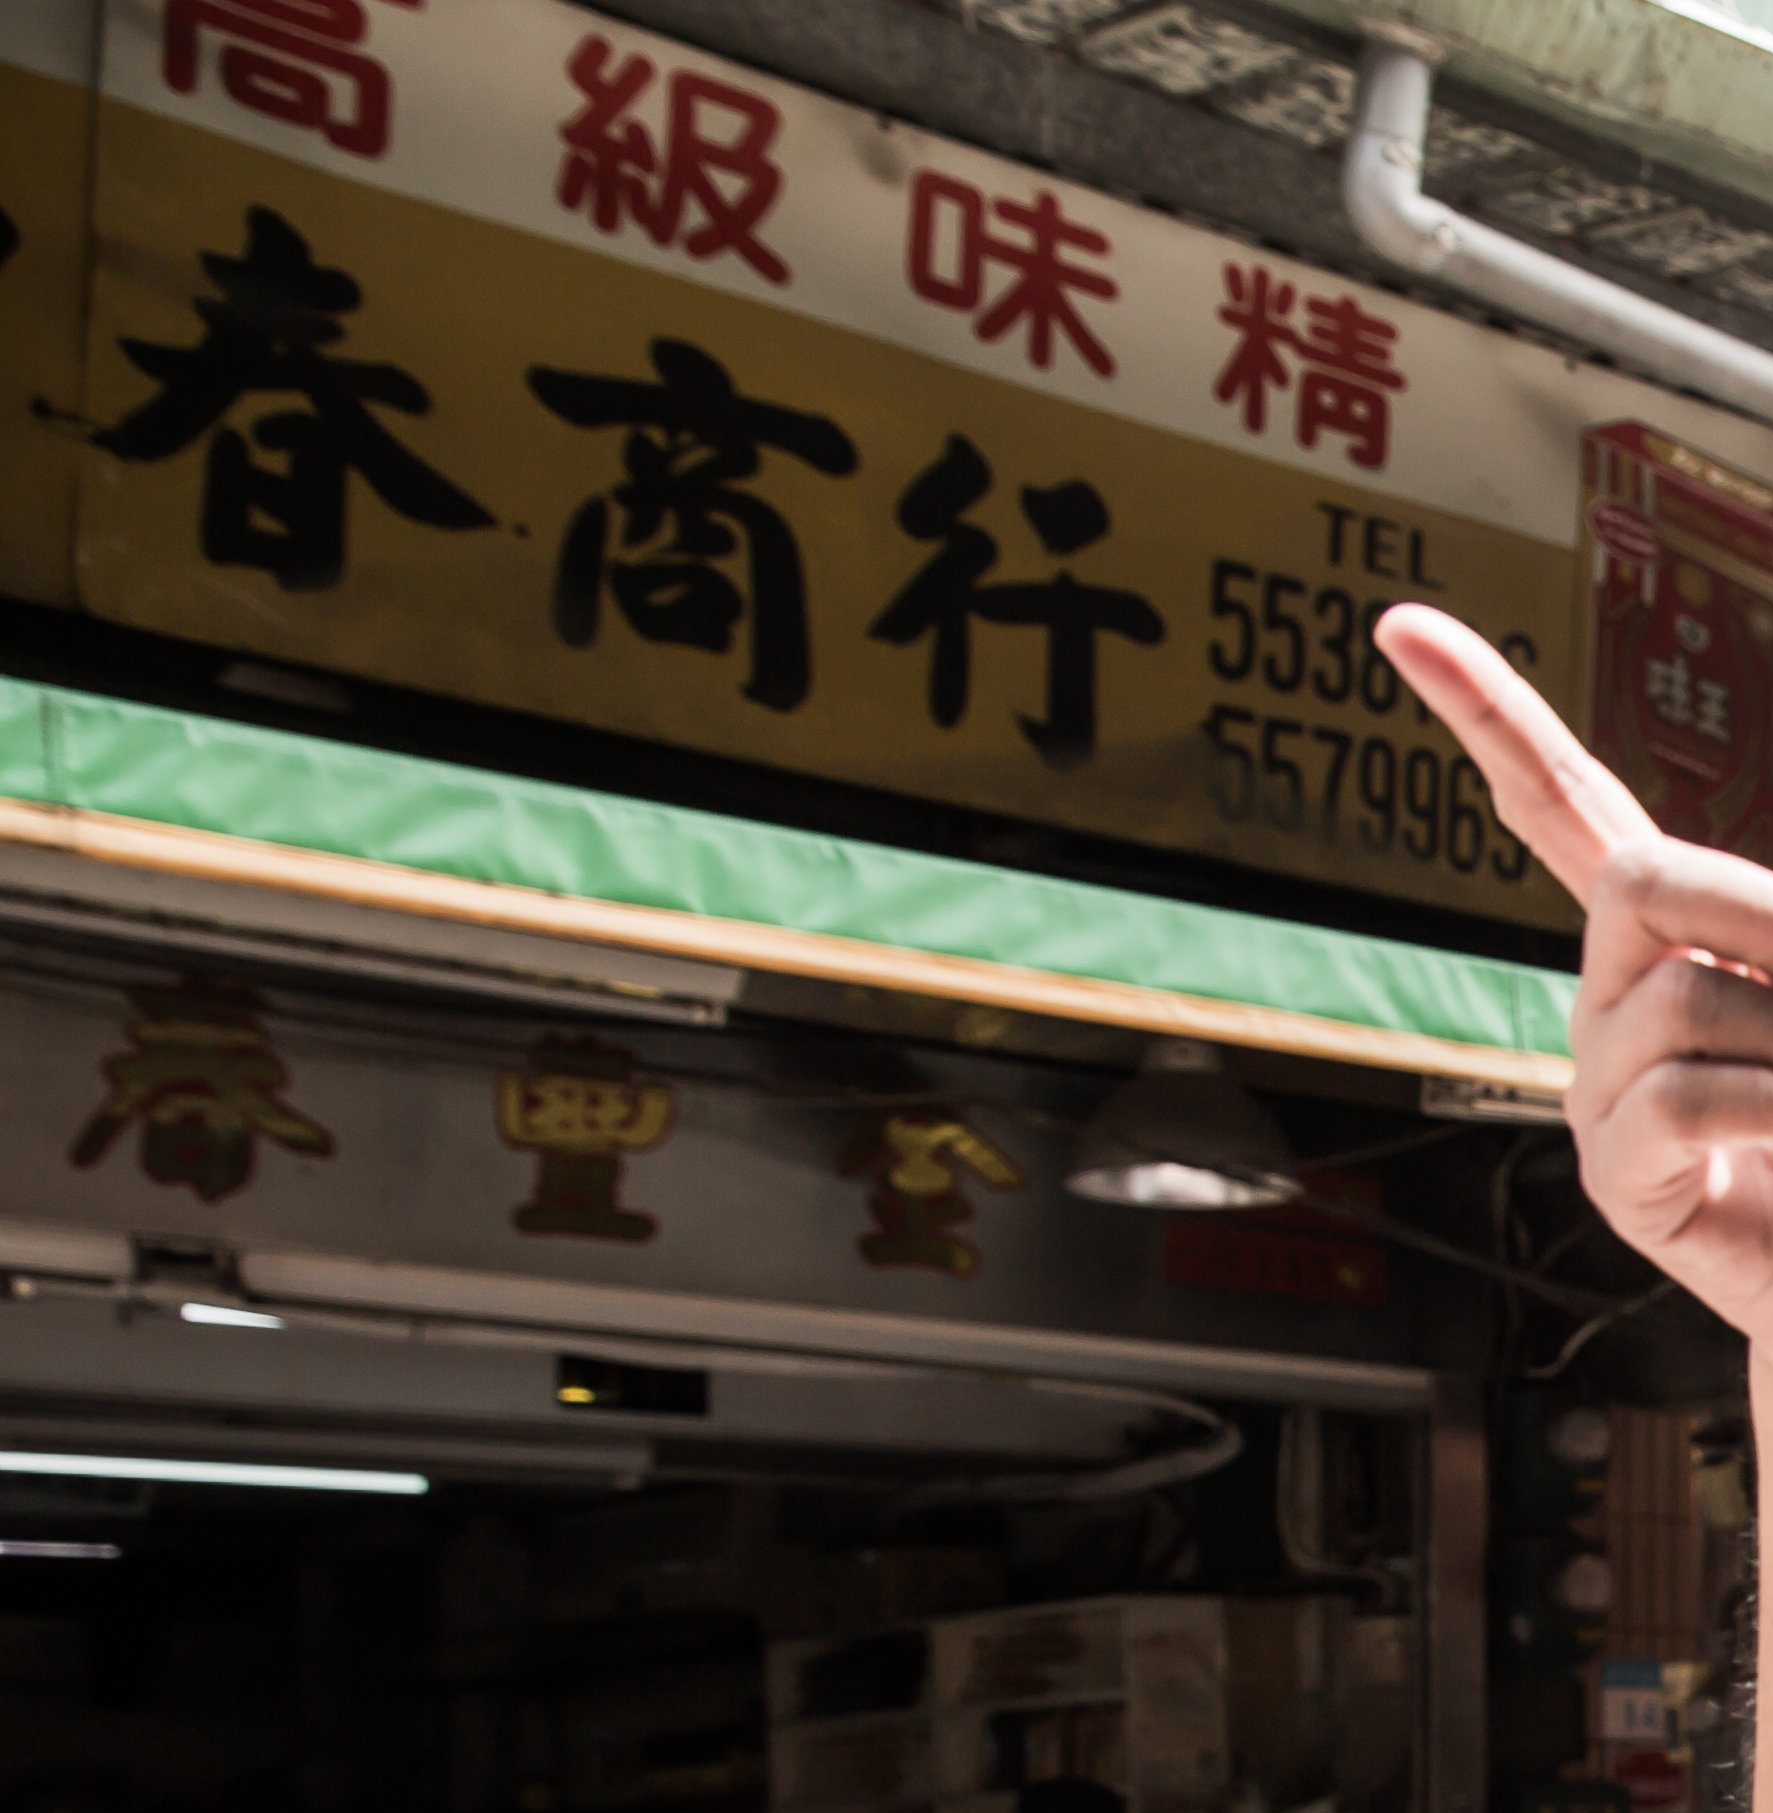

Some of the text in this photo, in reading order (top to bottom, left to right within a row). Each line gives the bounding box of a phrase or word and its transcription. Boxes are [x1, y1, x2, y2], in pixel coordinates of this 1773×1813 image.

[162, 0, 1407, 471] 高級味精
[0, 206, 1167, 771] 春商行
[1208, 555, 1538, 725] 5538
[1318, 502, 1447, 593] TEL
